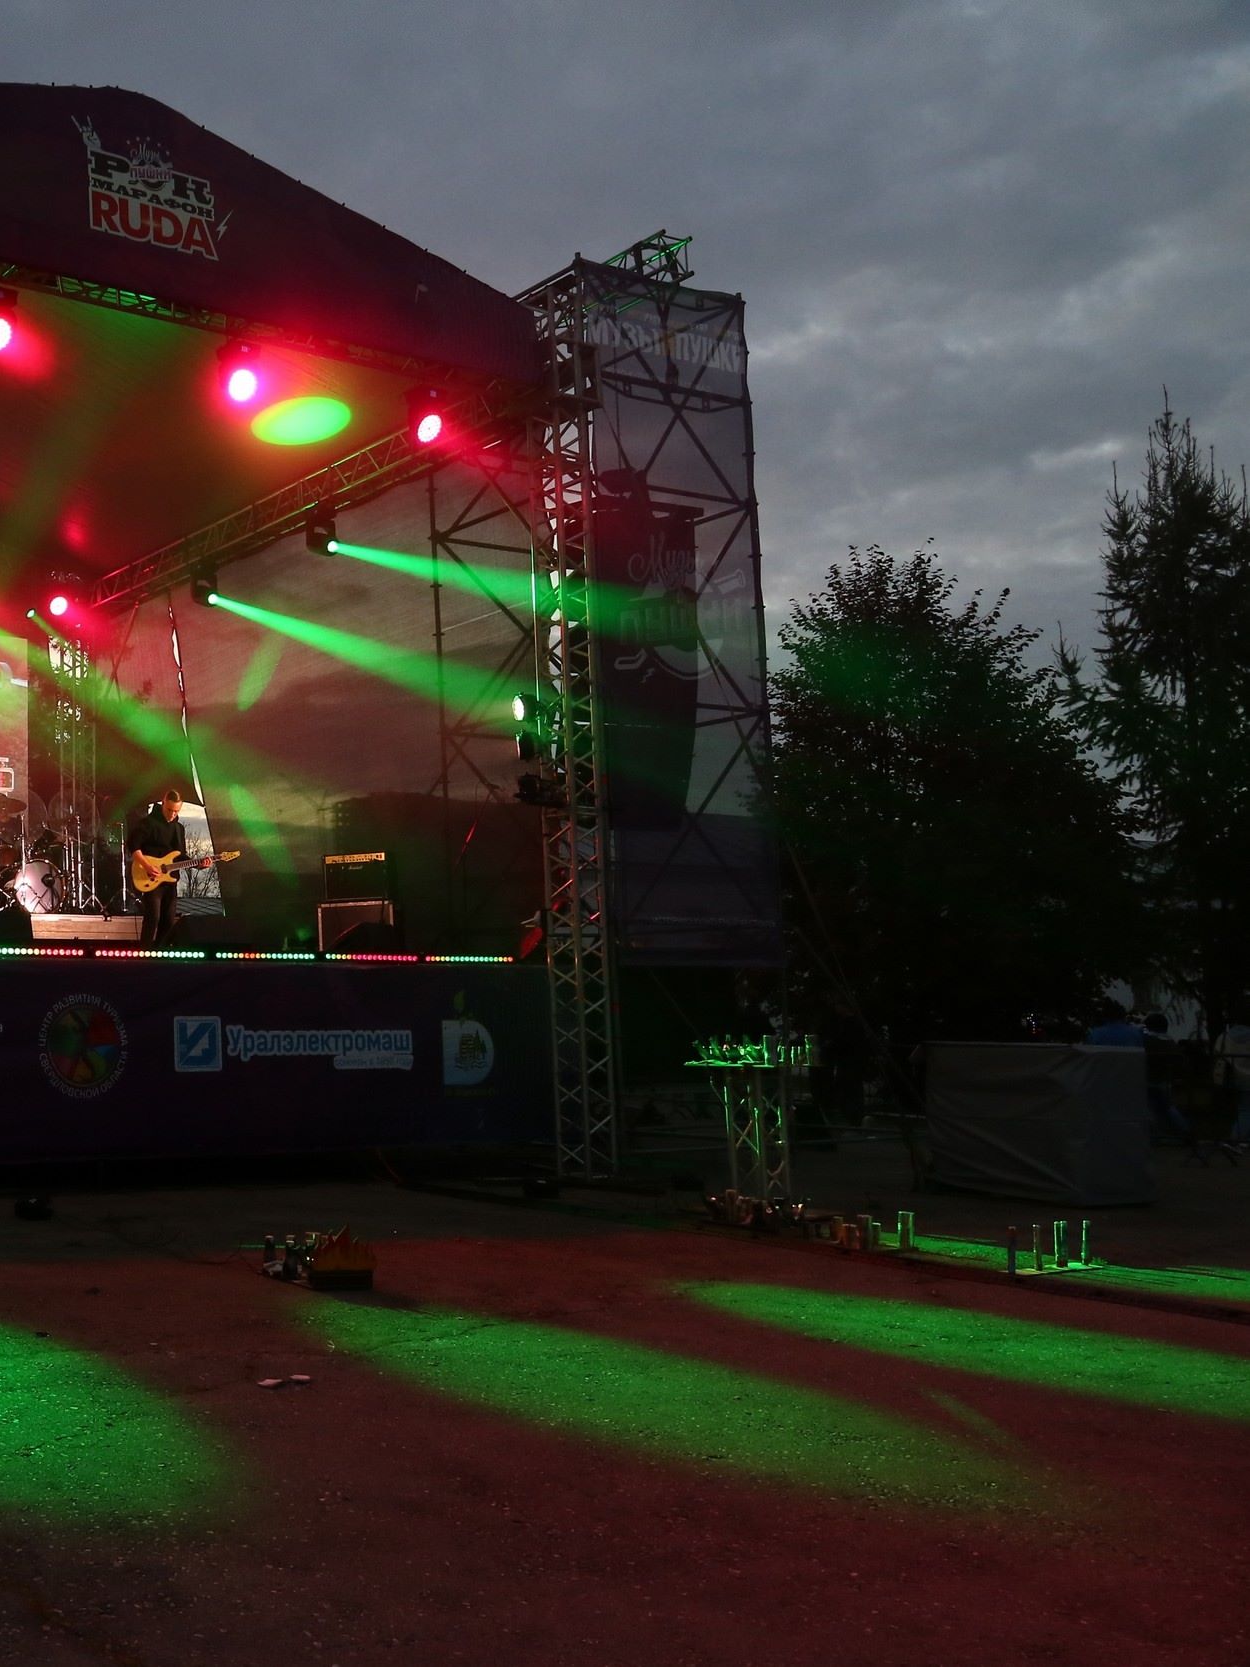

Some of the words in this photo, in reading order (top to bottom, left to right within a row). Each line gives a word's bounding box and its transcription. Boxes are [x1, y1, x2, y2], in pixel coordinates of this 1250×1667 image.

[90, 177, 213, 219] МАРАФОН
[90, 190, 218, 259] RUDA
[227, 1027, 411, 1059] Уралэлектромаш
